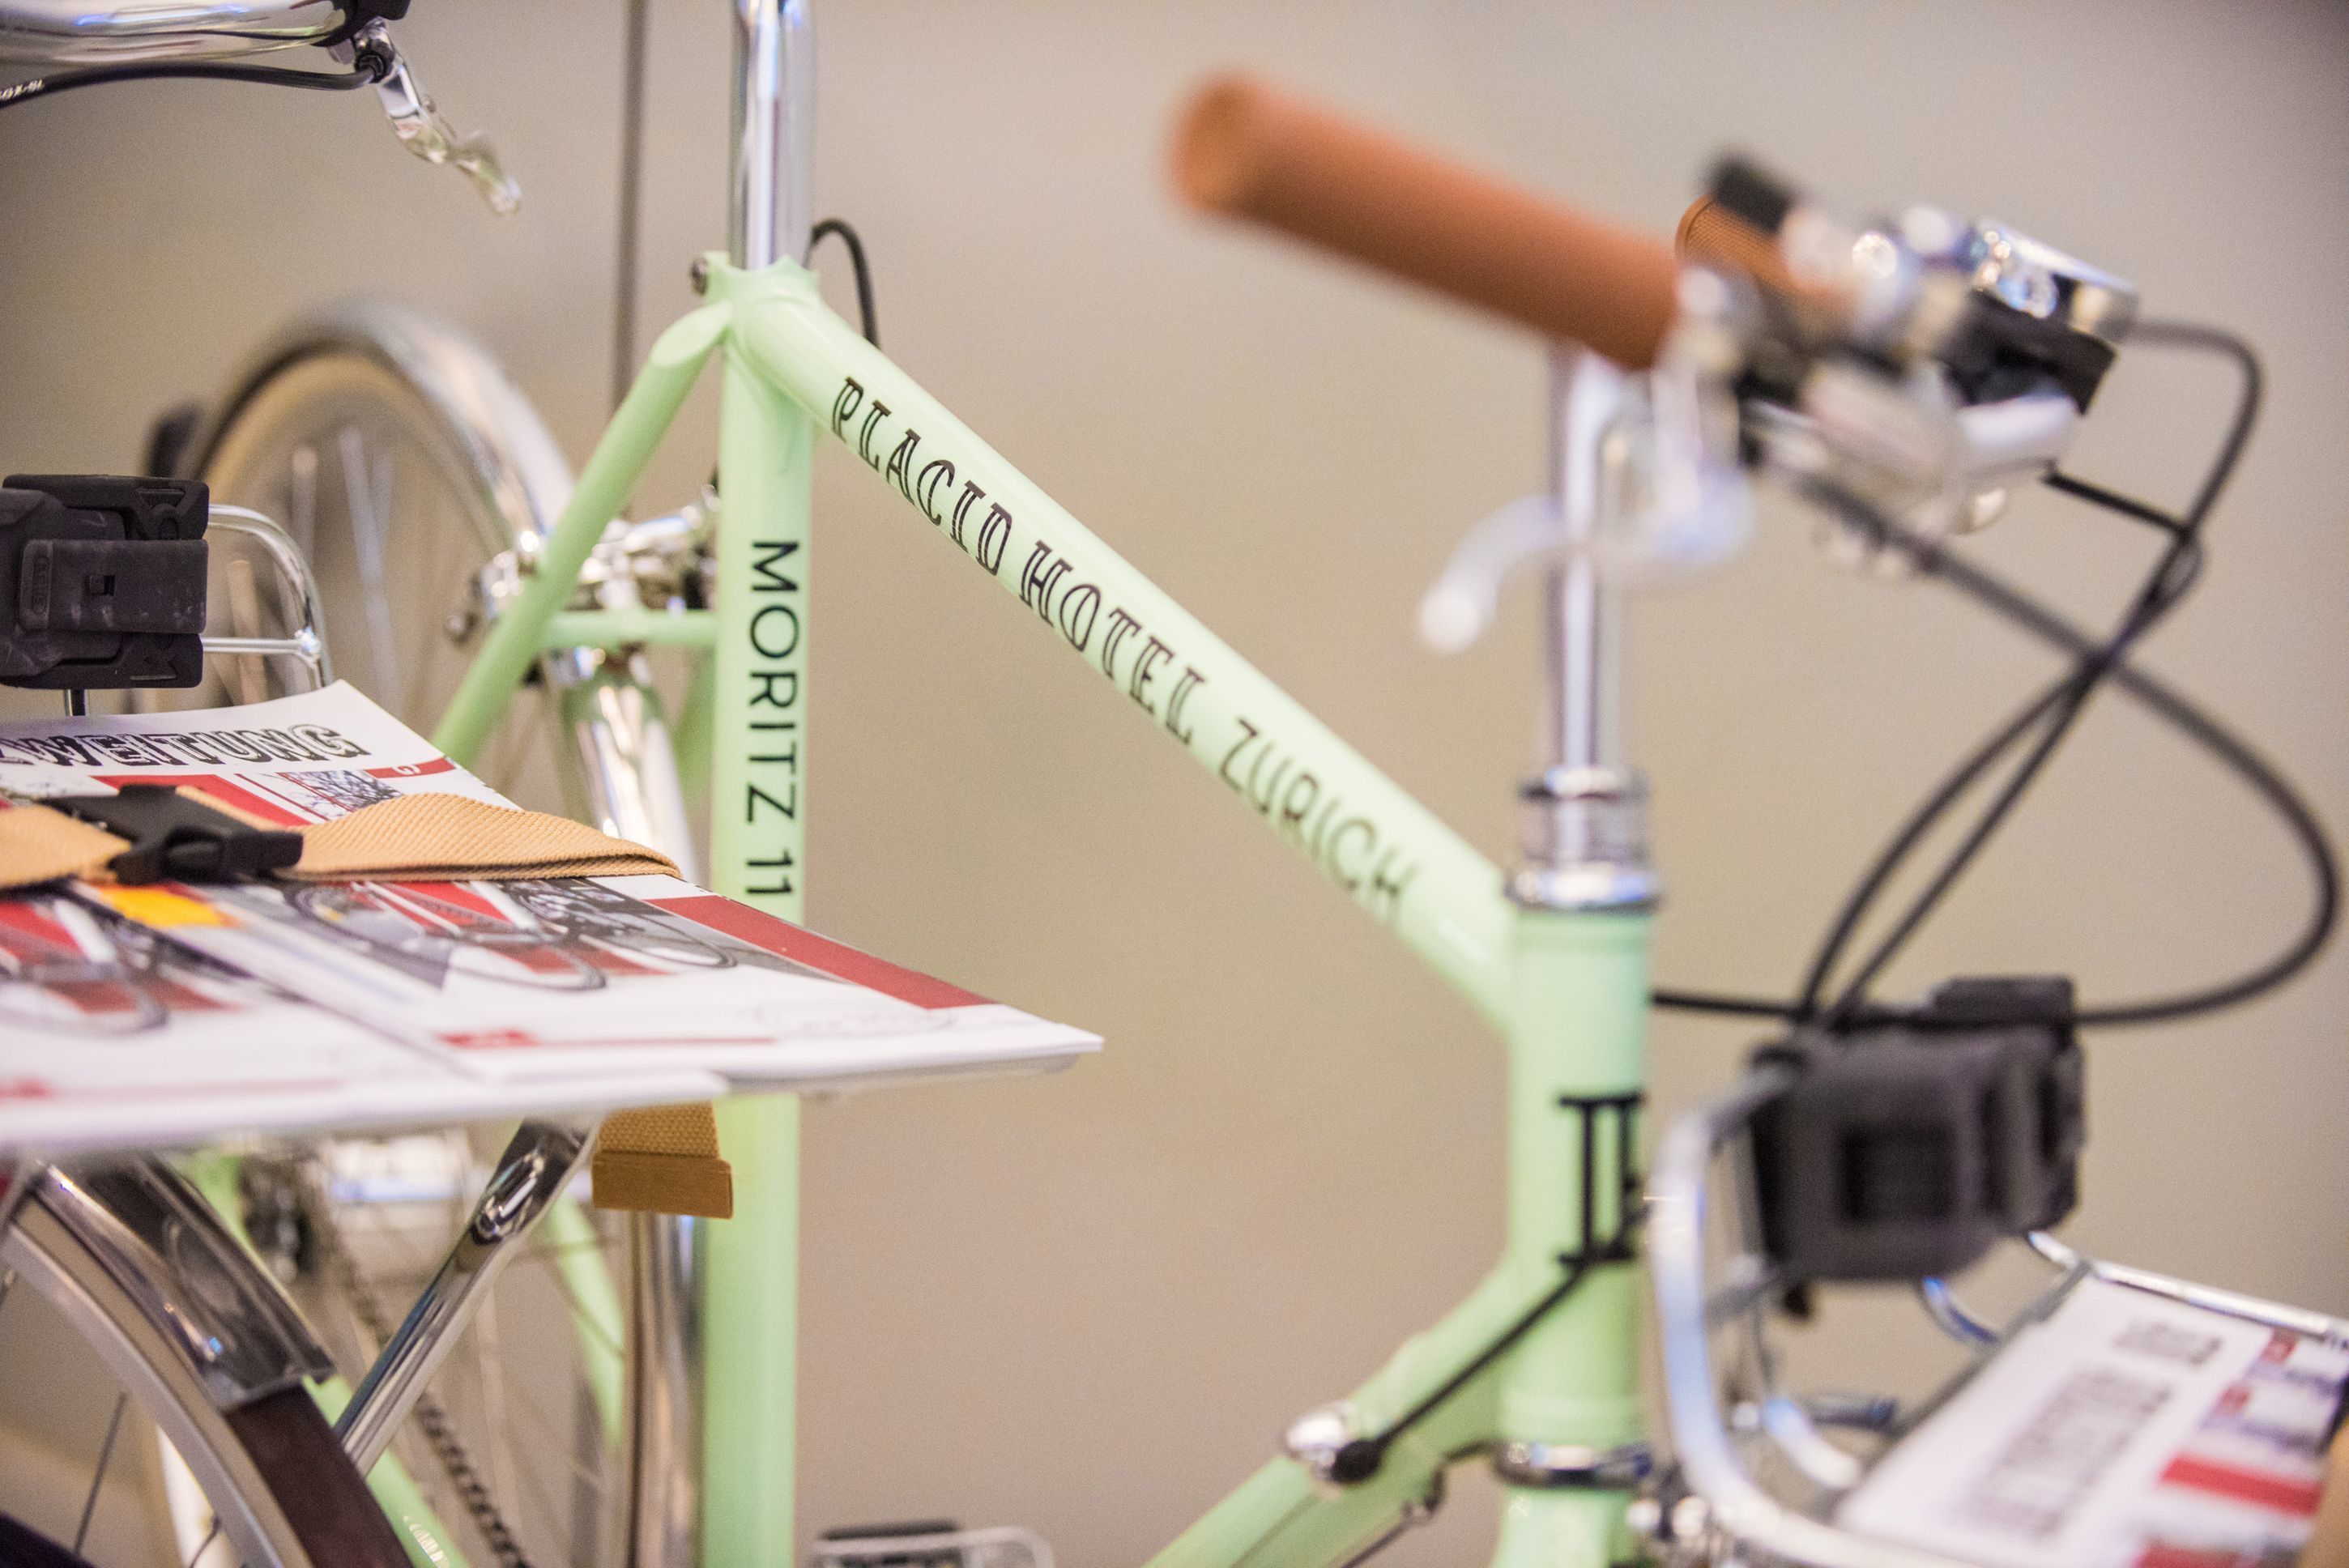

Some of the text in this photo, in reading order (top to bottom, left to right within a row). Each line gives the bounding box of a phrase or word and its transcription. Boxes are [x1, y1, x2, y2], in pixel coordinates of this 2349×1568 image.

[744, 540, 800, 897] MORITZ 11
[832, 376, 1013, 576] PLACID
[1019, 539, 1206, 745] HOTEL
